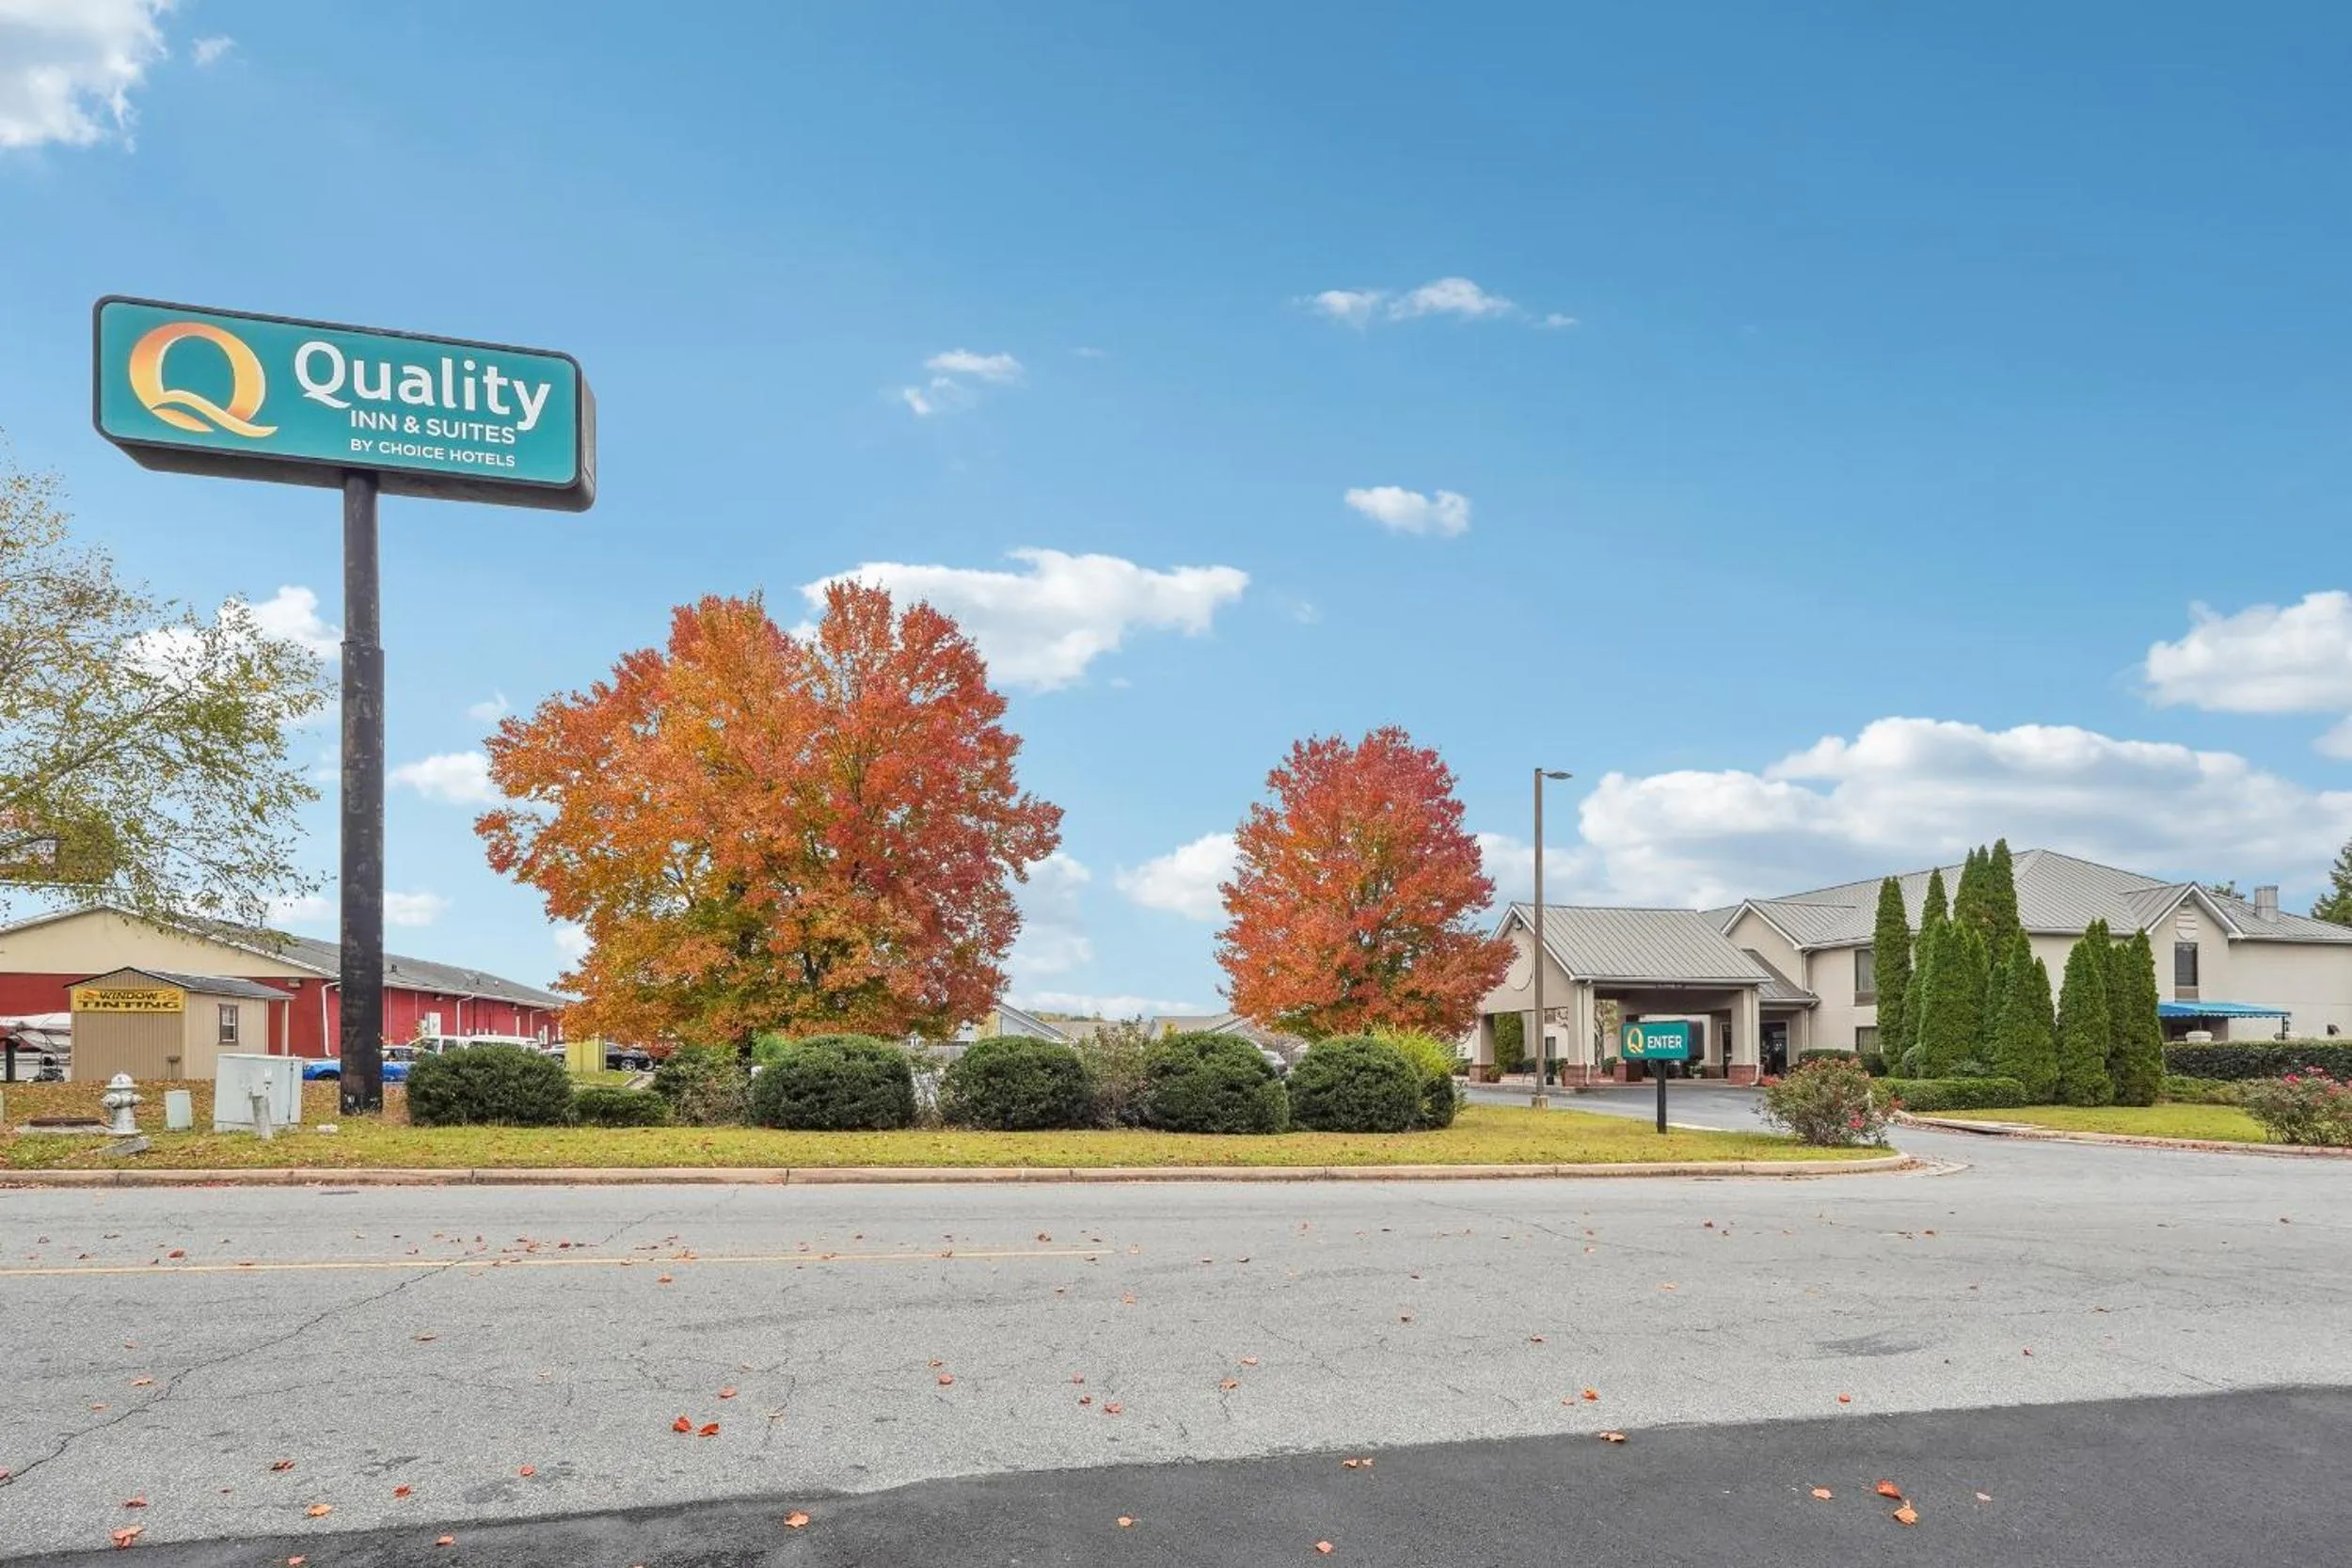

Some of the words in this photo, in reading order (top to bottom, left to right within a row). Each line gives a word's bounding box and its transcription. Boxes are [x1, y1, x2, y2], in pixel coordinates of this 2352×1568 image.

[294, 341, 551, 431] Quality
[351, 410, 397, 432] INN
[404, 416, 421, 435] &
[426, 419, 516, 445] SUITES
[351, 438, 373, 452] BY
[379, 442, 445, 460] CHOICE
[450, 449, 516, 467] HOTELS
[78, 1000, 180, 1008] TINTING
[99, 991, 158, 1000] WINDOW
[1647, 1036, 1683, 1049] ENTER
